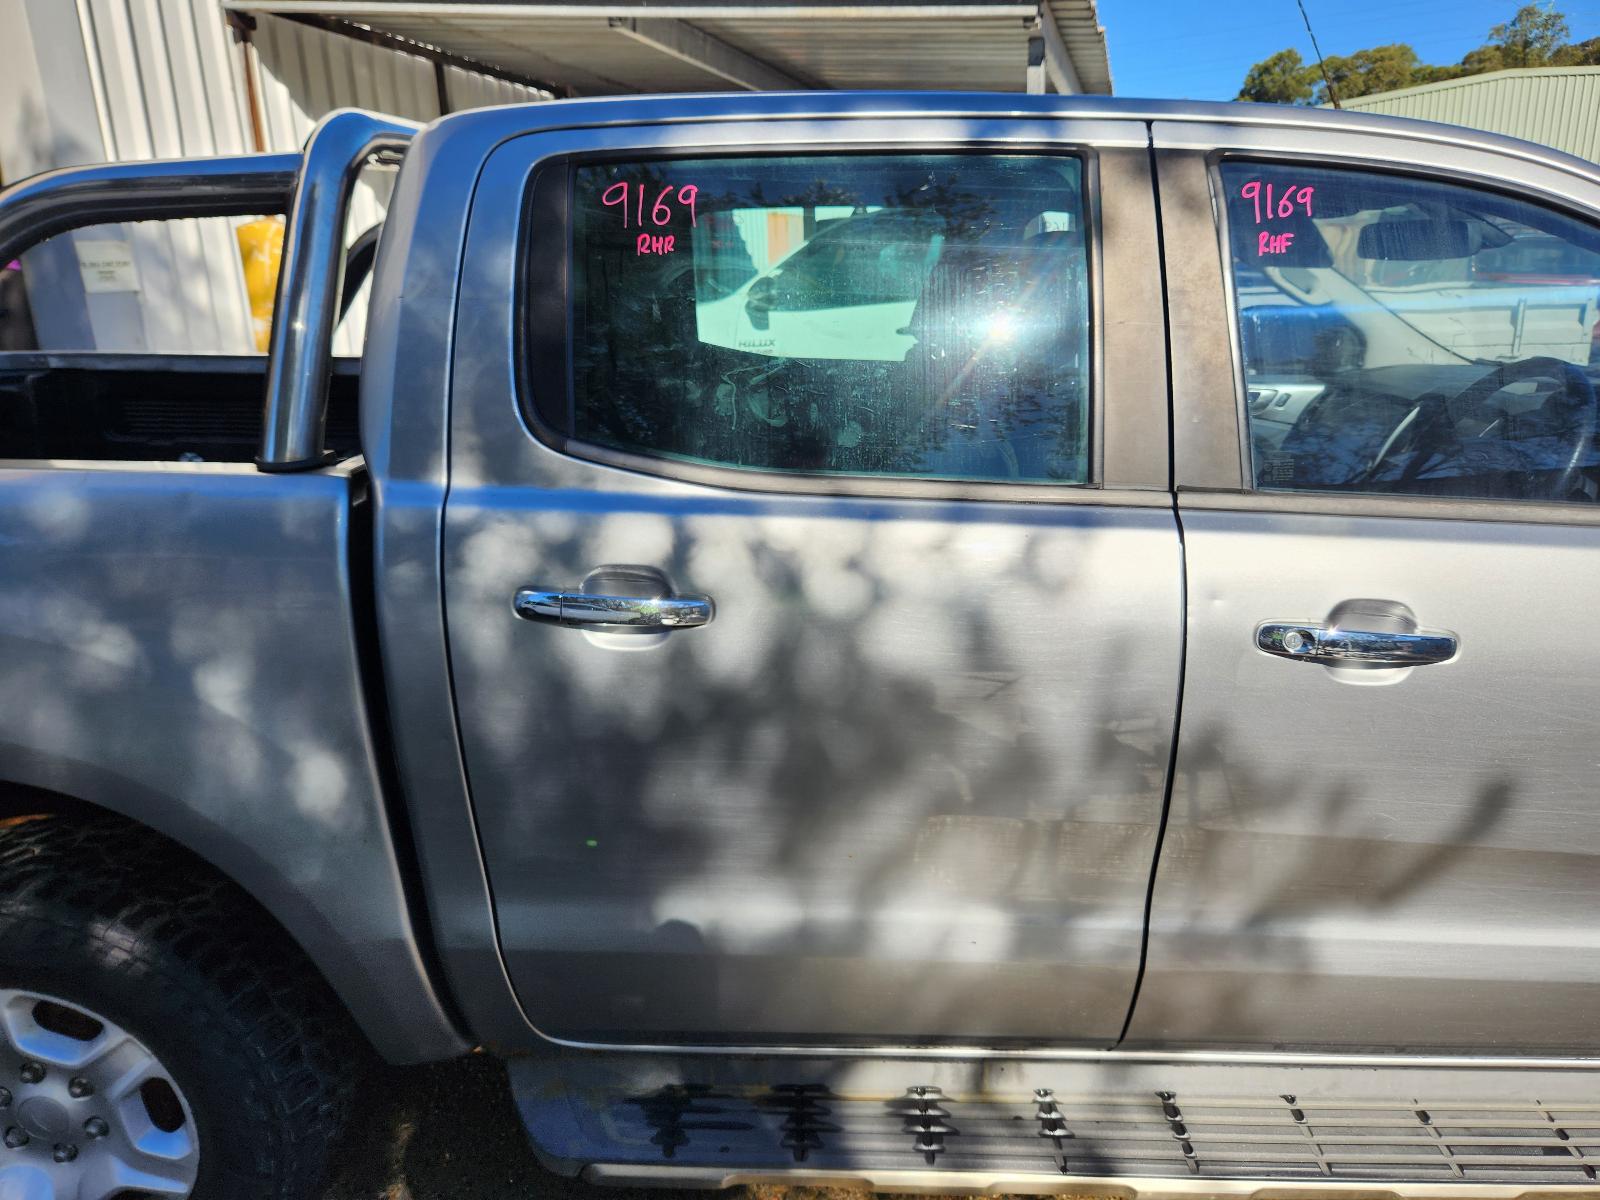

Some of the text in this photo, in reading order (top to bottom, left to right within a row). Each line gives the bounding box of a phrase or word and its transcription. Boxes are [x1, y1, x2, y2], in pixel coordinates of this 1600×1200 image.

[602, 181, 699, 229] 9169
[1241, 181, 1315, 224] 9169
[637, 233, 676, 256] RHR
[1258, 231, 1295, 257] RHF
